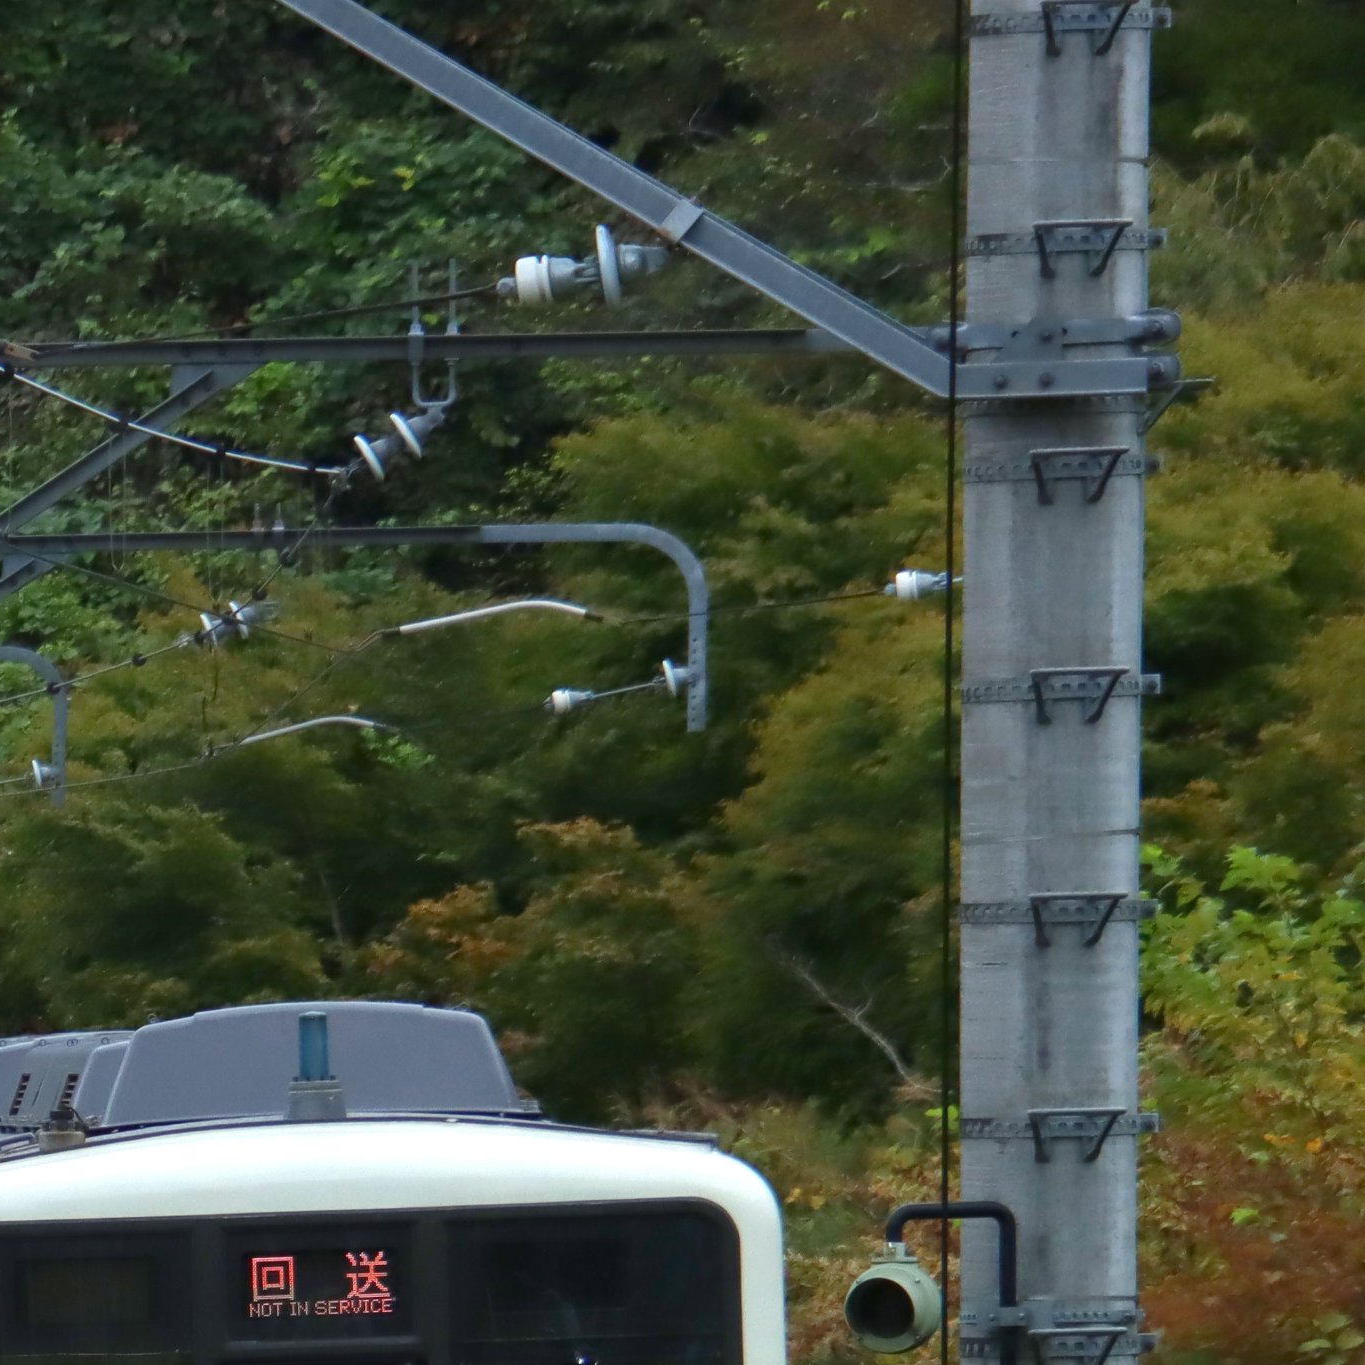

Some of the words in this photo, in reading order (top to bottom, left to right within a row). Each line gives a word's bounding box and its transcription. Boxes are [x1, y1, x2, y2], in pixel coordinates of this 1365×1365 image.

[252, 1251, 390, 1302] 回送
[249, 1302, 283, 1317] NOT
[290, 1301, 308, 1316] IN
[315, 1299, 394, 1315] SERVICE
